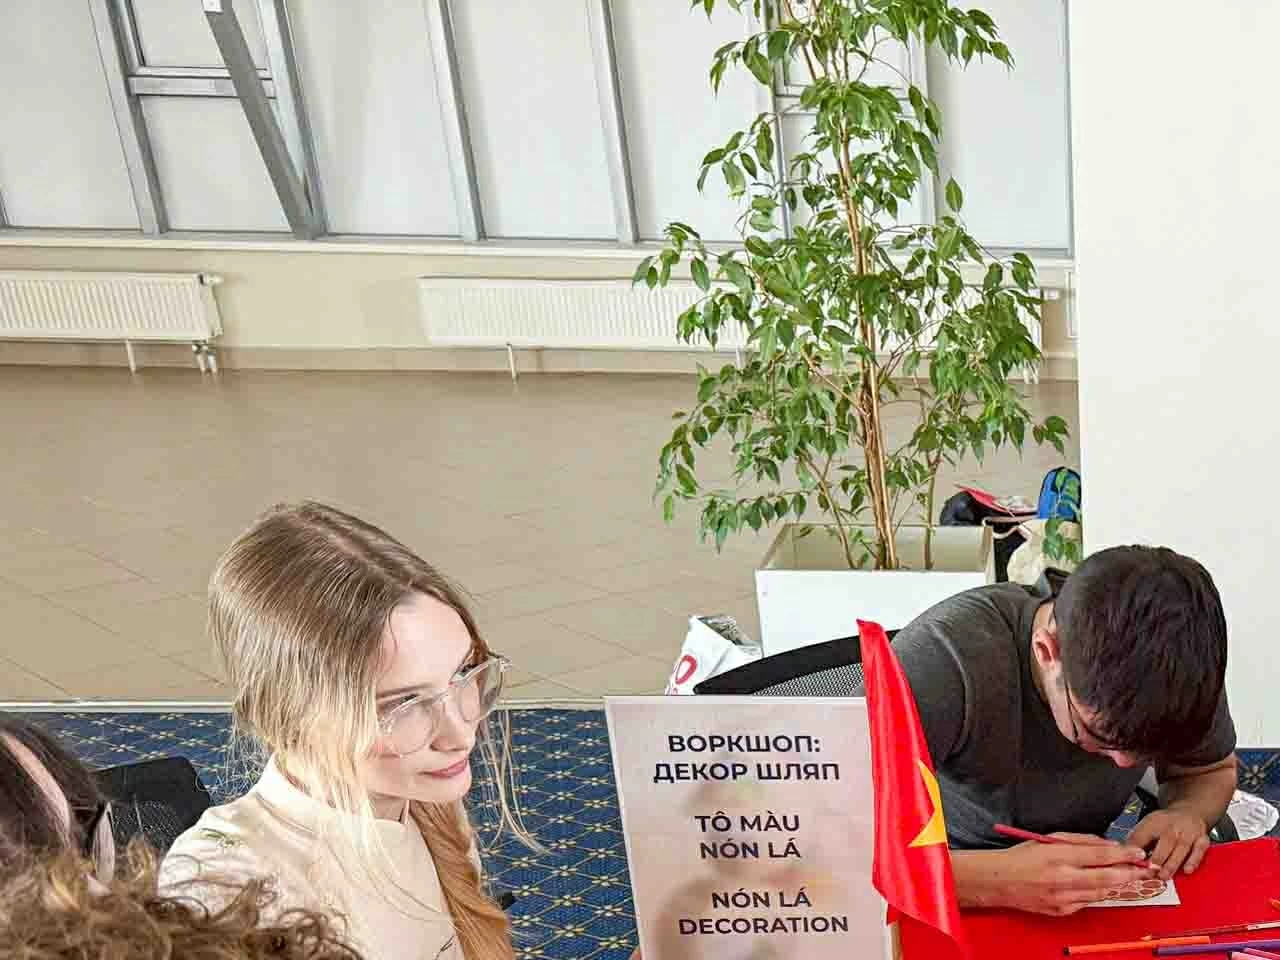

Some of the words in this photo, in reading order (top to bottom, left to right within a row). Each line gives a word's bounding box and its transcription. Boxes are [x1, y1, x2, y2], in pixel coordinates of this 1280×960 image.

[668, 734, 821, 753] ВОРКШОП:
[653, 762, 748, 783] ДЕКОР
[756, 763, 841, 781] ШЛЯП
[694, 810, 732, 833] TÔ
[740, 810, 801, 833] MÀU
[700, 837, 760, 860] NÓN
[767, 837, 802, 860] LÁ
[711, 887, 771, 909] NÓN
[778, 886, 812, 909] LÁ
[678, 916, 850, 936] DECORATION
